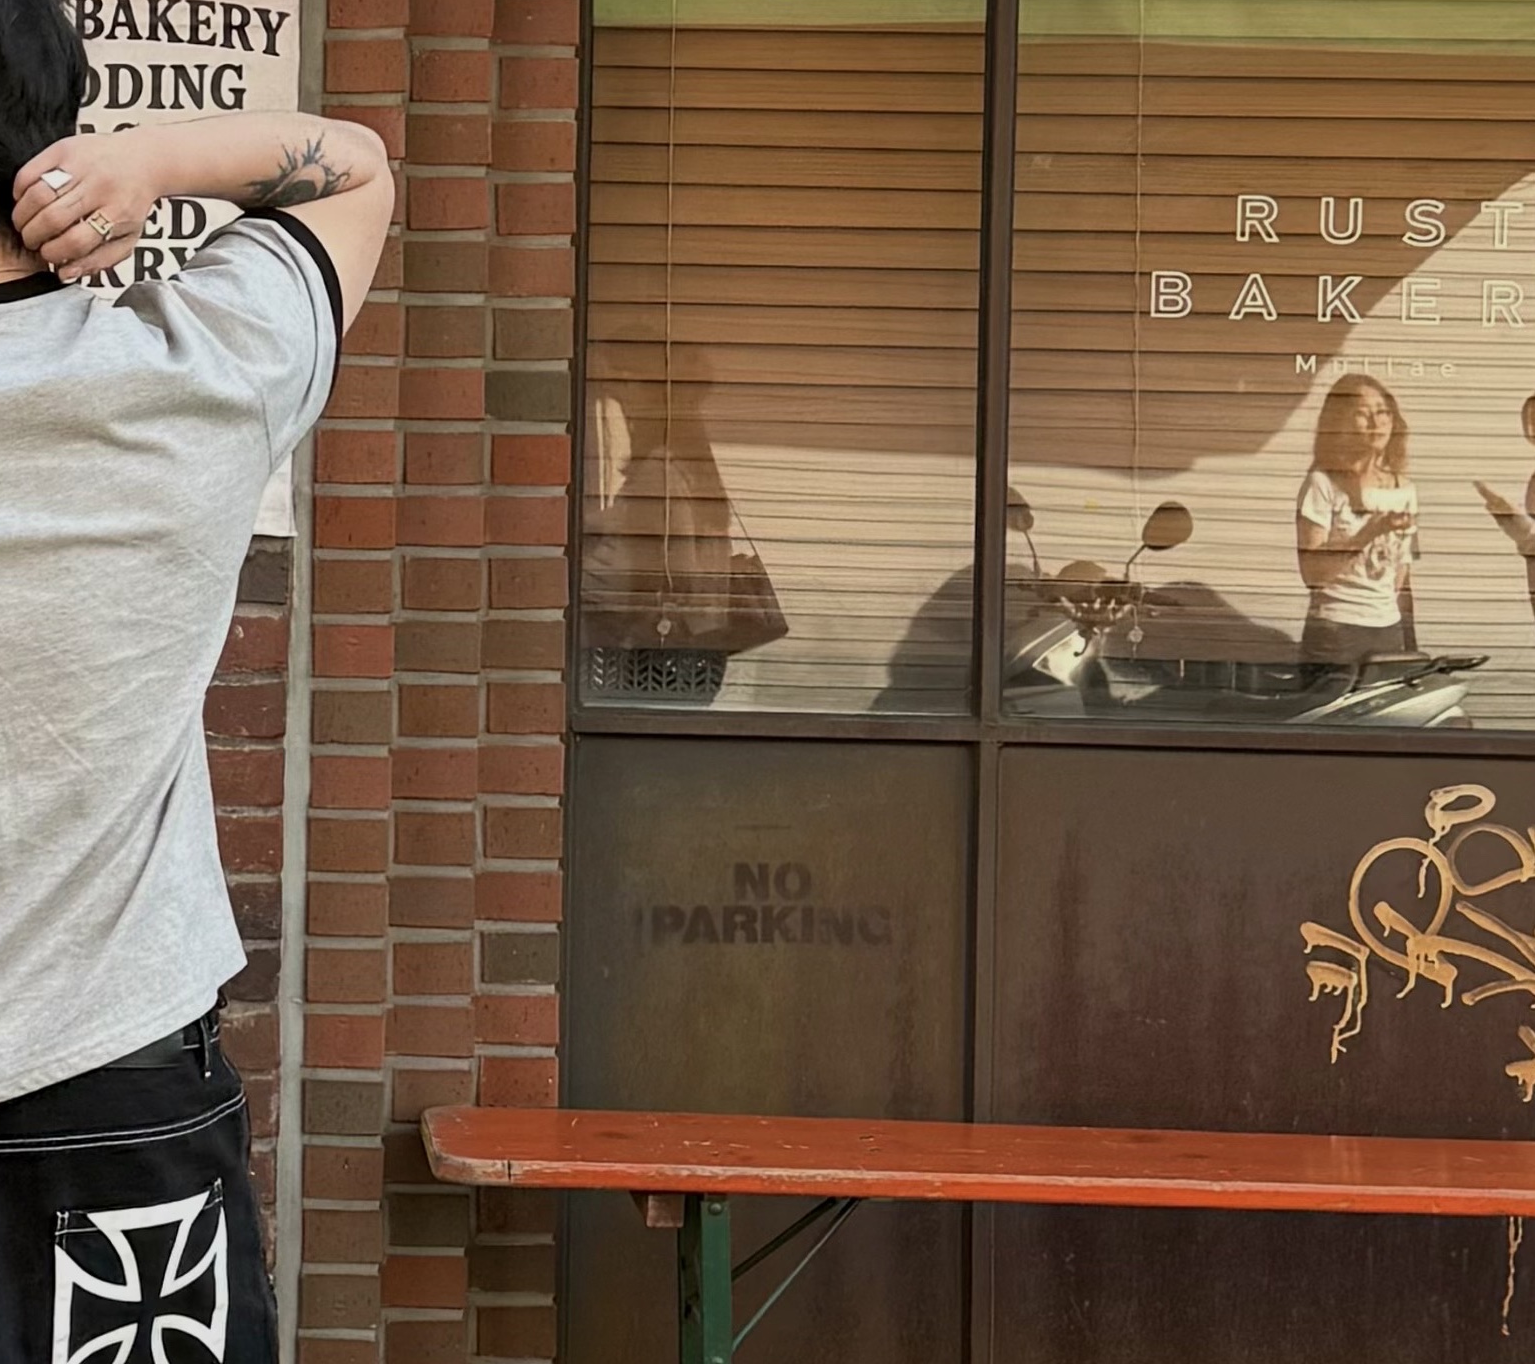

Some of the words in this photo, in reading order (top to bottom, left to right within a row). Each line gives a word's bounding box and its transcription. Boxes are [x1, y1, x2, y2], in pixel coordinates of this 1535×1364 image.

[1235, 194, 1525, 249] RUST
[1149, 270, 1526, 329] BAKER
[733, 861, 812, 901] NO
[649, 904, 892, 945] PARKING
